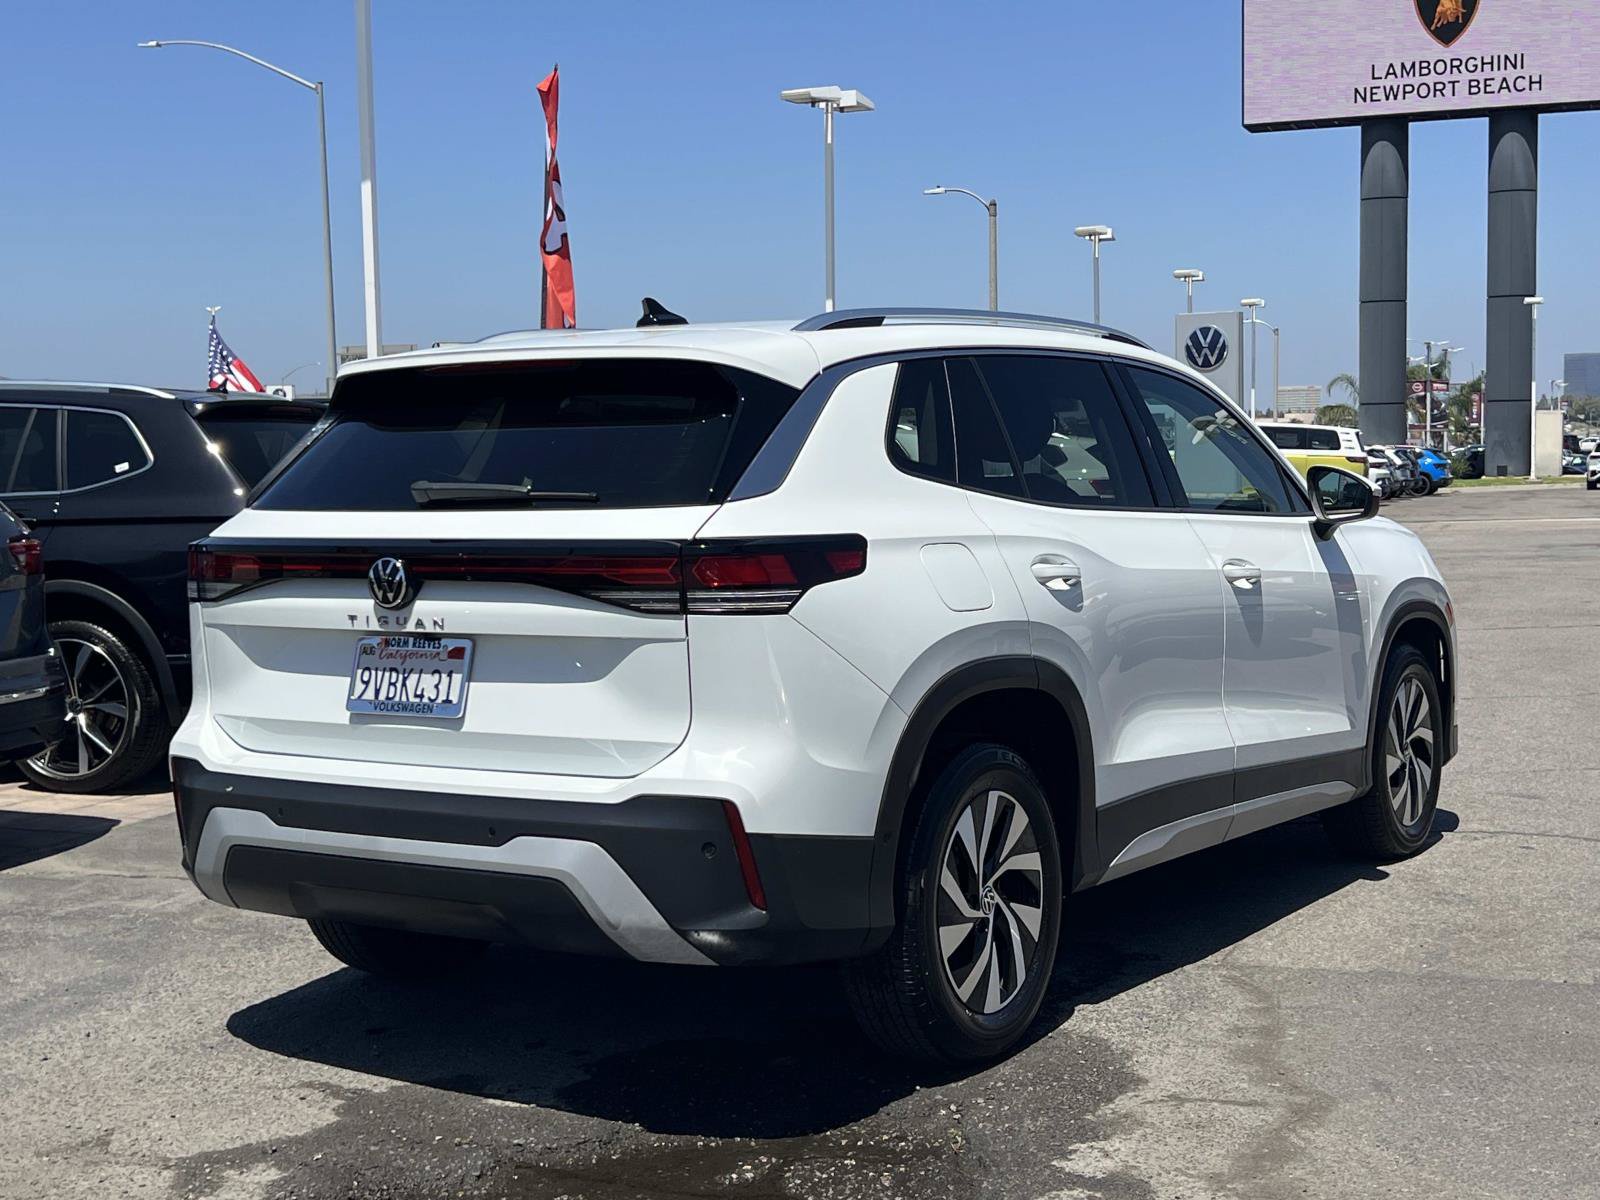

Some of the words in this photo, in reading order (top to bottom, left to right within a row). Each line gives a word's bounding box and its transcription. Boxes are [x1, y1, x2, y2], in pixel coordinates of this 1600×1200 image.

[1370, 53, 1525, 81] LAMBORGHINI
[1353, 80, 1461, 104] NEWPORT
[1468, 74, 1543, 96] BEACH
[347, 614, 446, 631] TIGUAN
[361, 646, 376, 656] AUG
[384, 637, 409, 648] NORM
[378, 647, 441, 666] California
[357, 666, 454, 704] 9VBK431
[373, 702, 435, 714] VOLKSWAGEN
